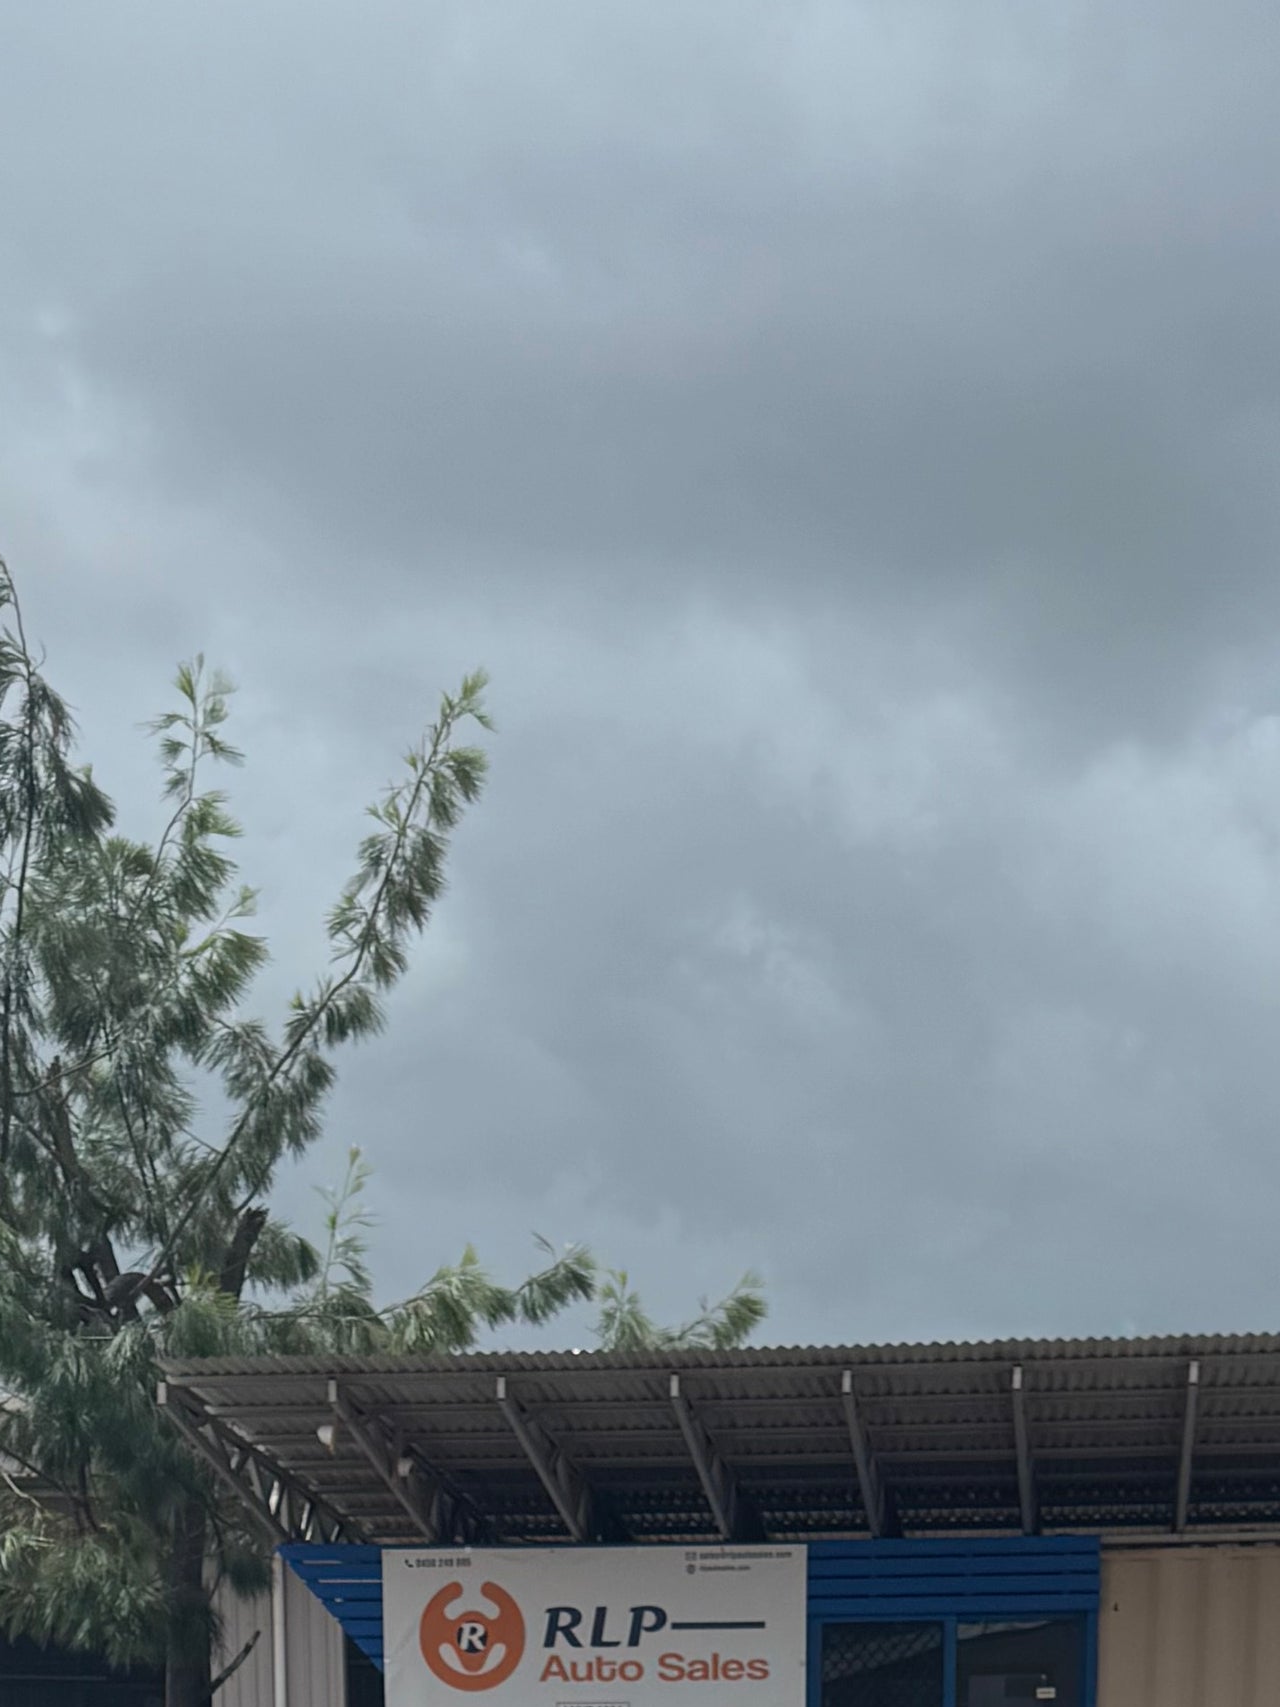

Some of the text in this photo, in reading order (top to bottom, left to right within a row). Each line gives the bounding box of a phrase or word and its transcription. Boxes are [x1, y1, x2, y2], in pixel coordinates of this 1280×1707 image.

[460, 1622, 485, 1650] R
[543, 1605, 668, 1648] RLP
[539, 1653, 770, 1682] Auto Sales
